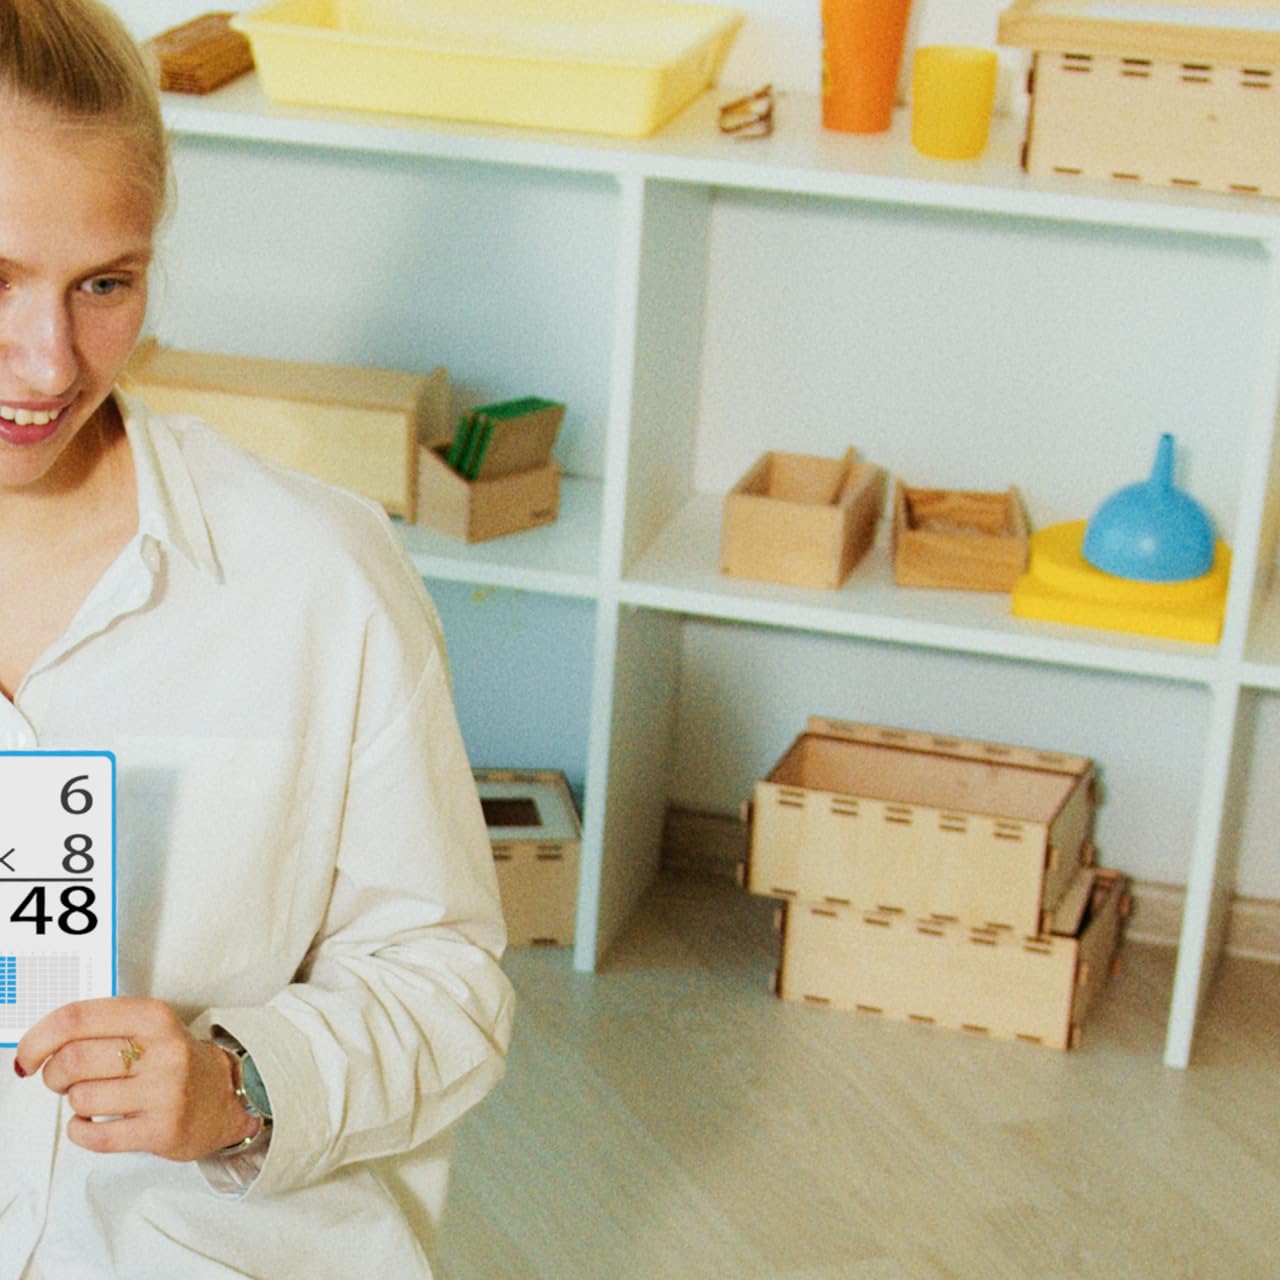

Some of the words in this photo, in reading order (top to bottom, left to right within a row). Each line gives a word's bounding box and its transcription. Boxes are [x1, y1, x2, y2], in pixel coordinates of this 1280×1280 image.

[60, 775, 94, 815] 6
[62, 834, 95, 874] 8
[9, 885, 98, 935] 48
